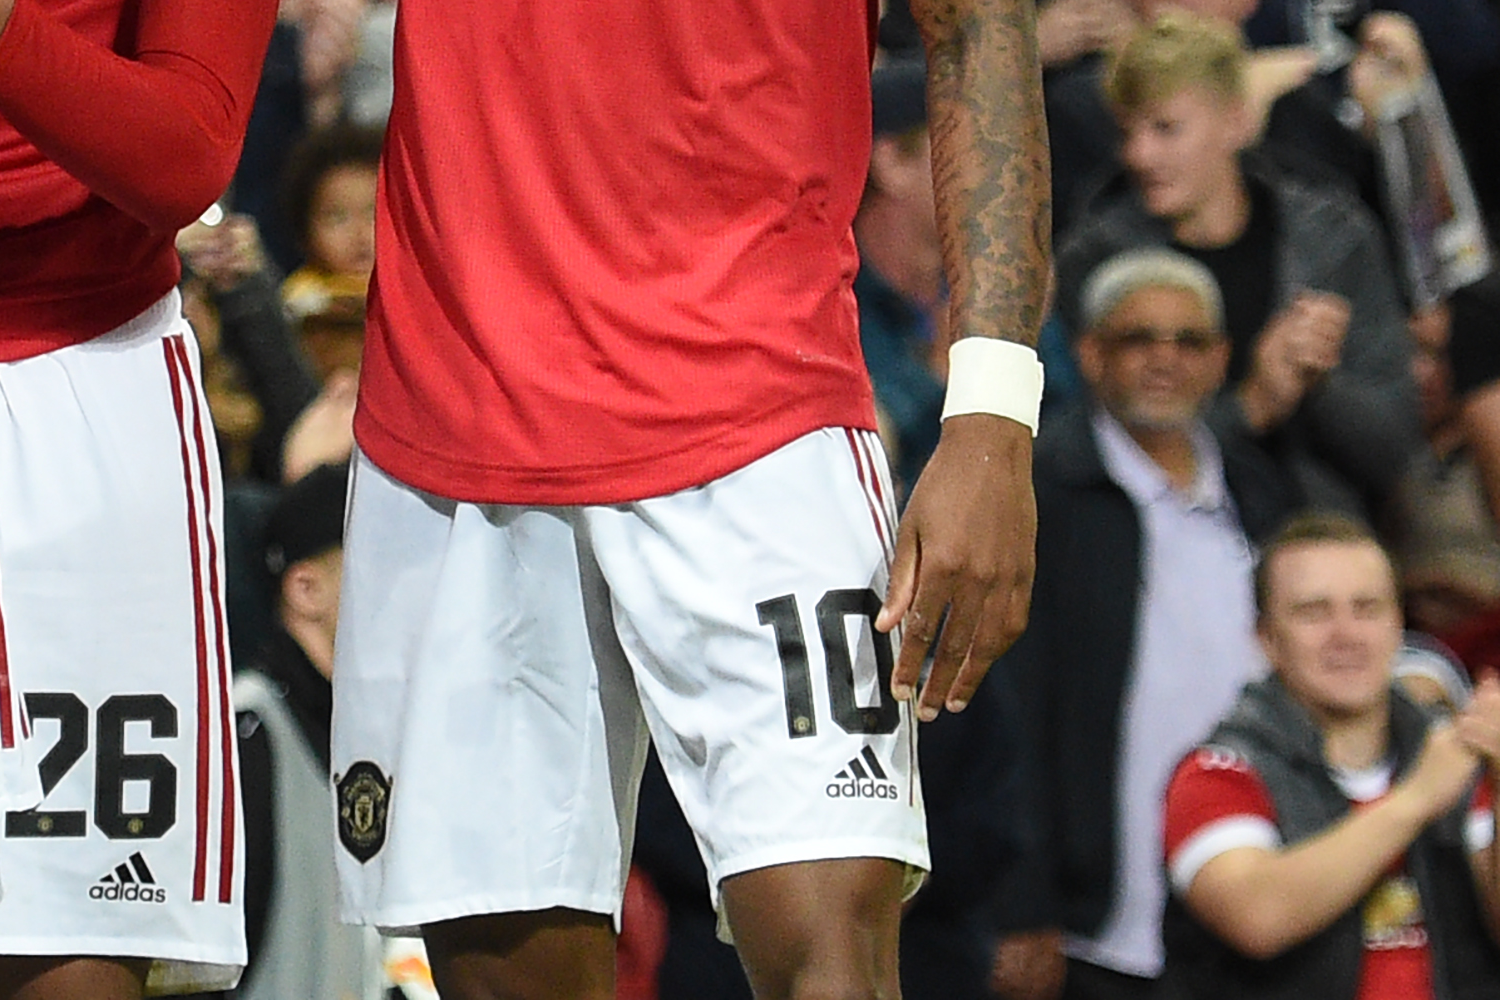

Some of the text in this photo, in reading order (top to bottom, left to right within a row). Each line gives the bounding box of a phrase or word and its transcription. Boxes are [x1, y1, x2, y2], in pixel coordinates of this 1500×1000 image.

[754, 587, 901, 740] 10
[3, 691, 180, 841] 26
[825, 778, 899, 801] adidas
[88, 881, 167, 904] adidas
